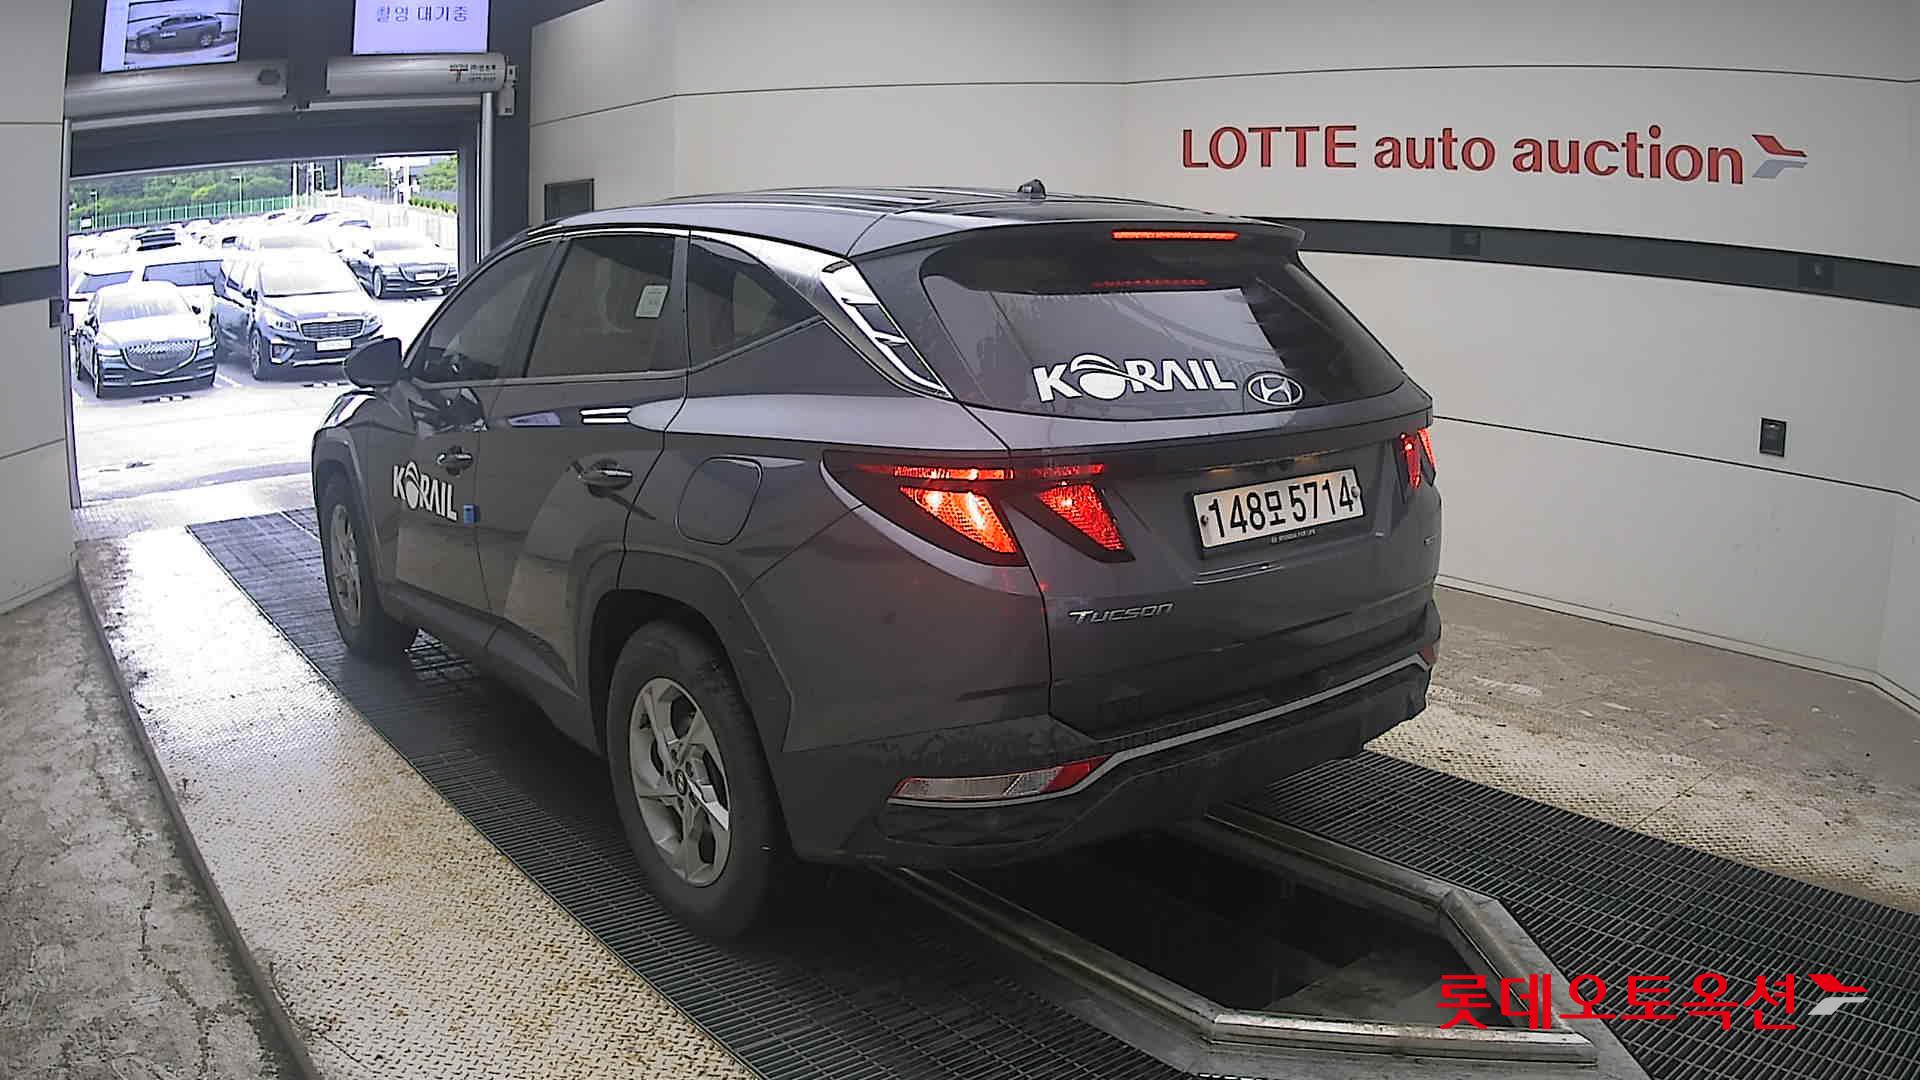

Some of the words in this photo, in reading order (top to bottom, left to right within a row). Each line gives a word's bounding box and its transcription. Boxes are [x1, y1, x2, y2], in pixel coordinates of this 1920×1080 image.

[416, 5, 468, 22] 대기중
[1182, 125, 1358, 169] LOTTE
[1374, 127, 1496, 171] auto
[1512, 124, 1744, 185] auction
[1032, 353, 1237, 402] KORAIL
[392, 460, 457, 522] KORAIL
